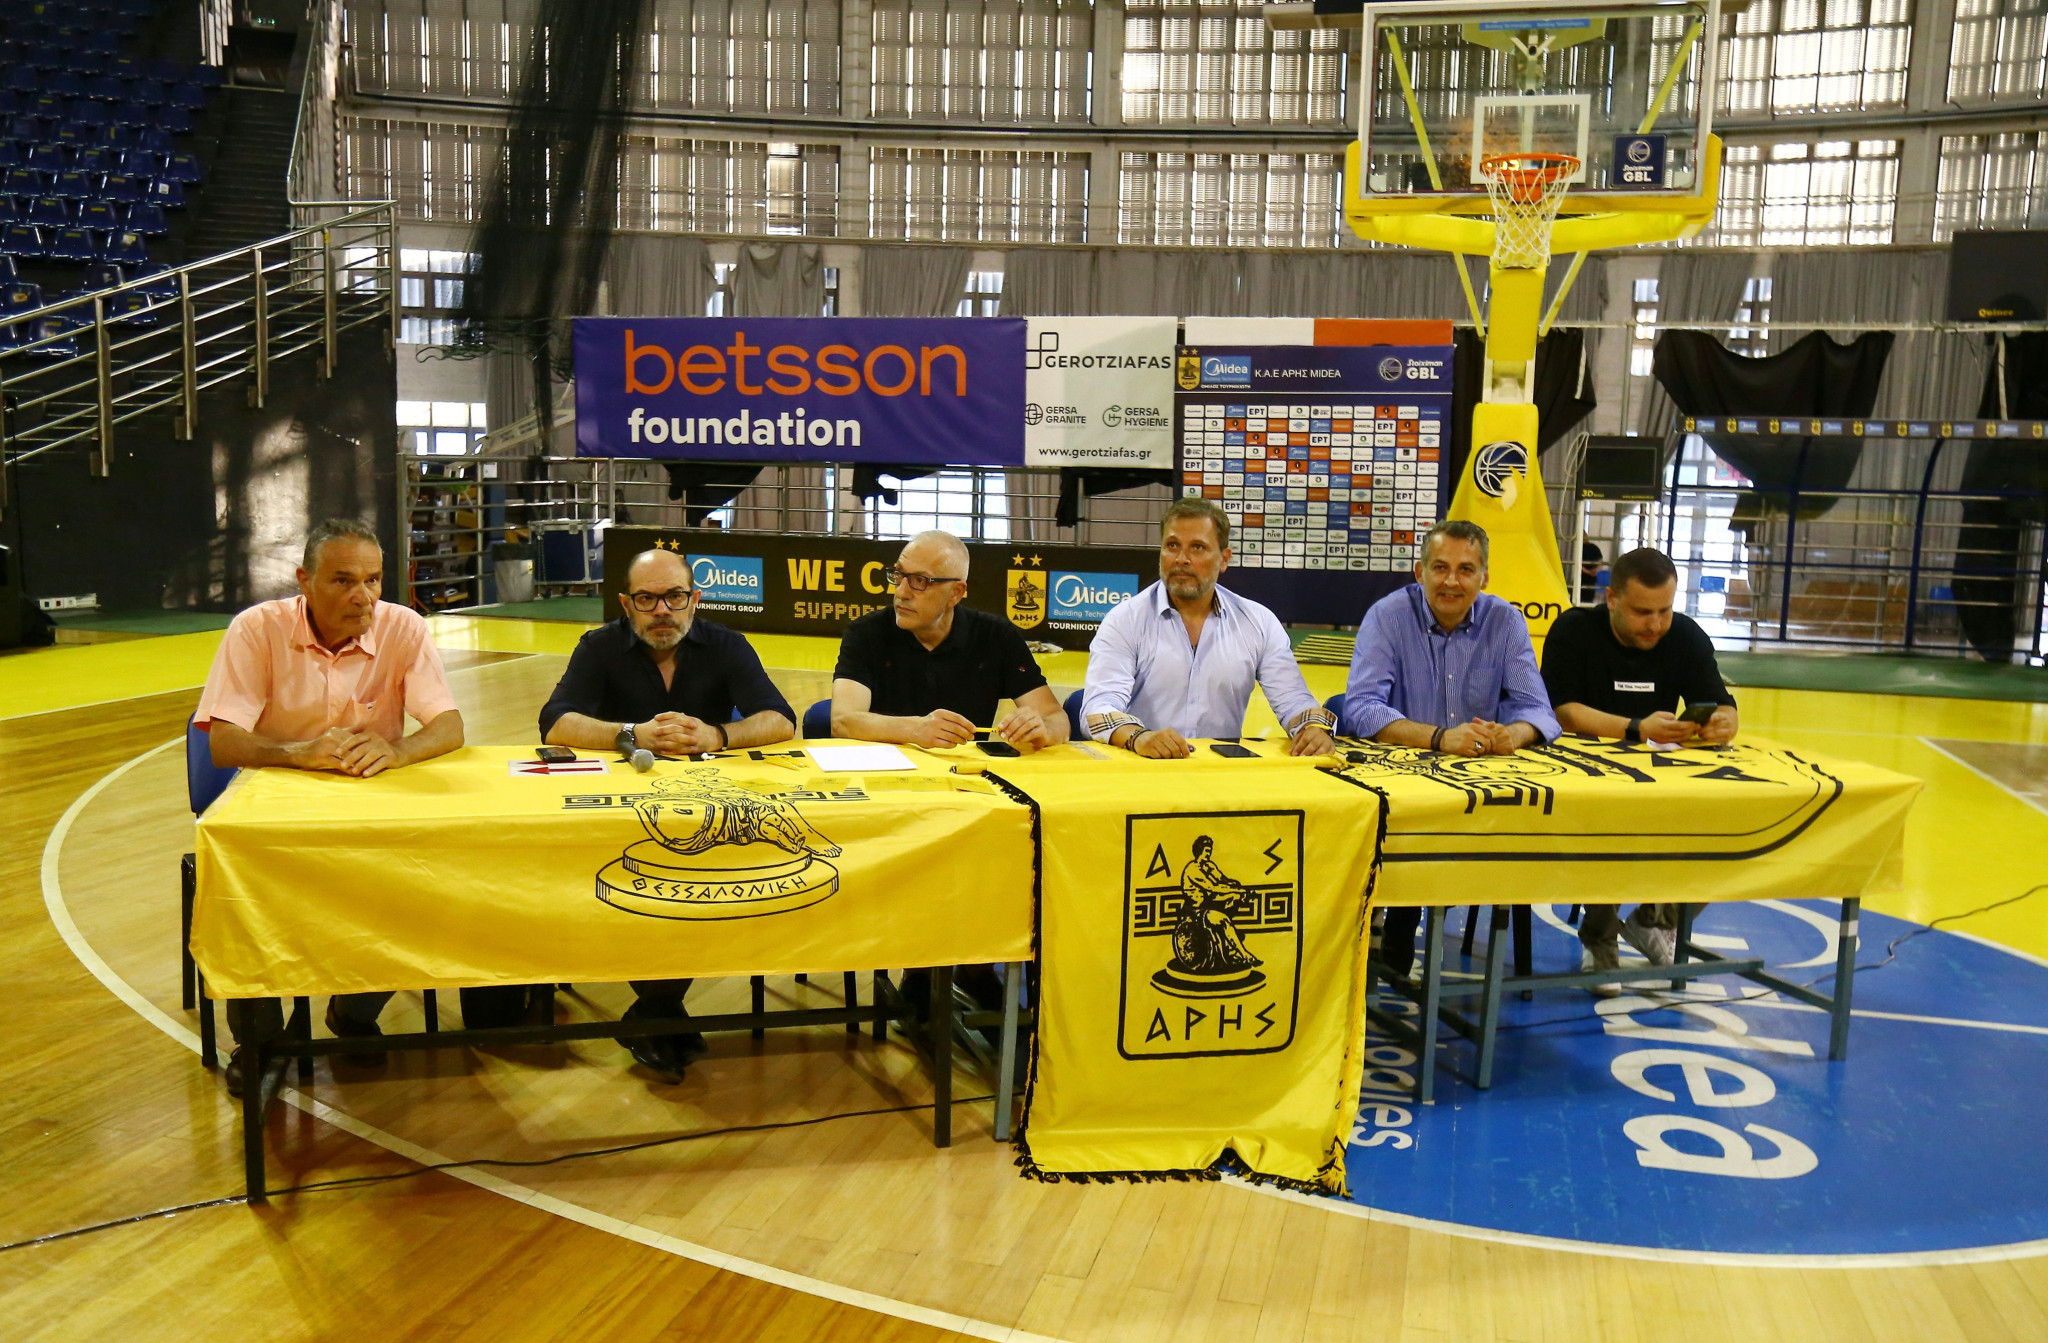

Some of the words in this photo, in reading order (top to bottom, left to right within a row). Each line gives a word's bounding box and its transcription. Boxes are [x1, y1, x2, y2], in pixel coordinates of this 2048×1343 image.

[1623, 171, 1652, 182] GBL
[625, 329, 966, 396] betsson
[1045, 355, 1172, 369] GEROTZIAFAS
[1207, 360, 1248, 375] Midea
[1282, 369, 1307, 378] ΑΡΗΣ
[1310, 369, 1341, 378] MIDEA
[1406, 367, 1439, 380] GBL
[1046, 406, 1077, 414] GERSA
[1125, 407, 1160, 416] GERSA
[1046, 415, 1086, 424] GRANITE
[1125, 417, 1168, 427] HYGIENE
[628, 407, 861, 447] foundation
[1039, 447, 1152, 460] www.gerotziafas.gr
[695, 563, 758, 588] Midea
[787, 558, 845, 592] WE
[718, 591, 758, 600] Technologies
[696, 603, 737, 611] URNIKIOTIS
[738, 604, 764, 613] GROUP
[794, 601, 887, 621] SUPPO
[1048, 621, 1100, 631] TOURNIKIOT
